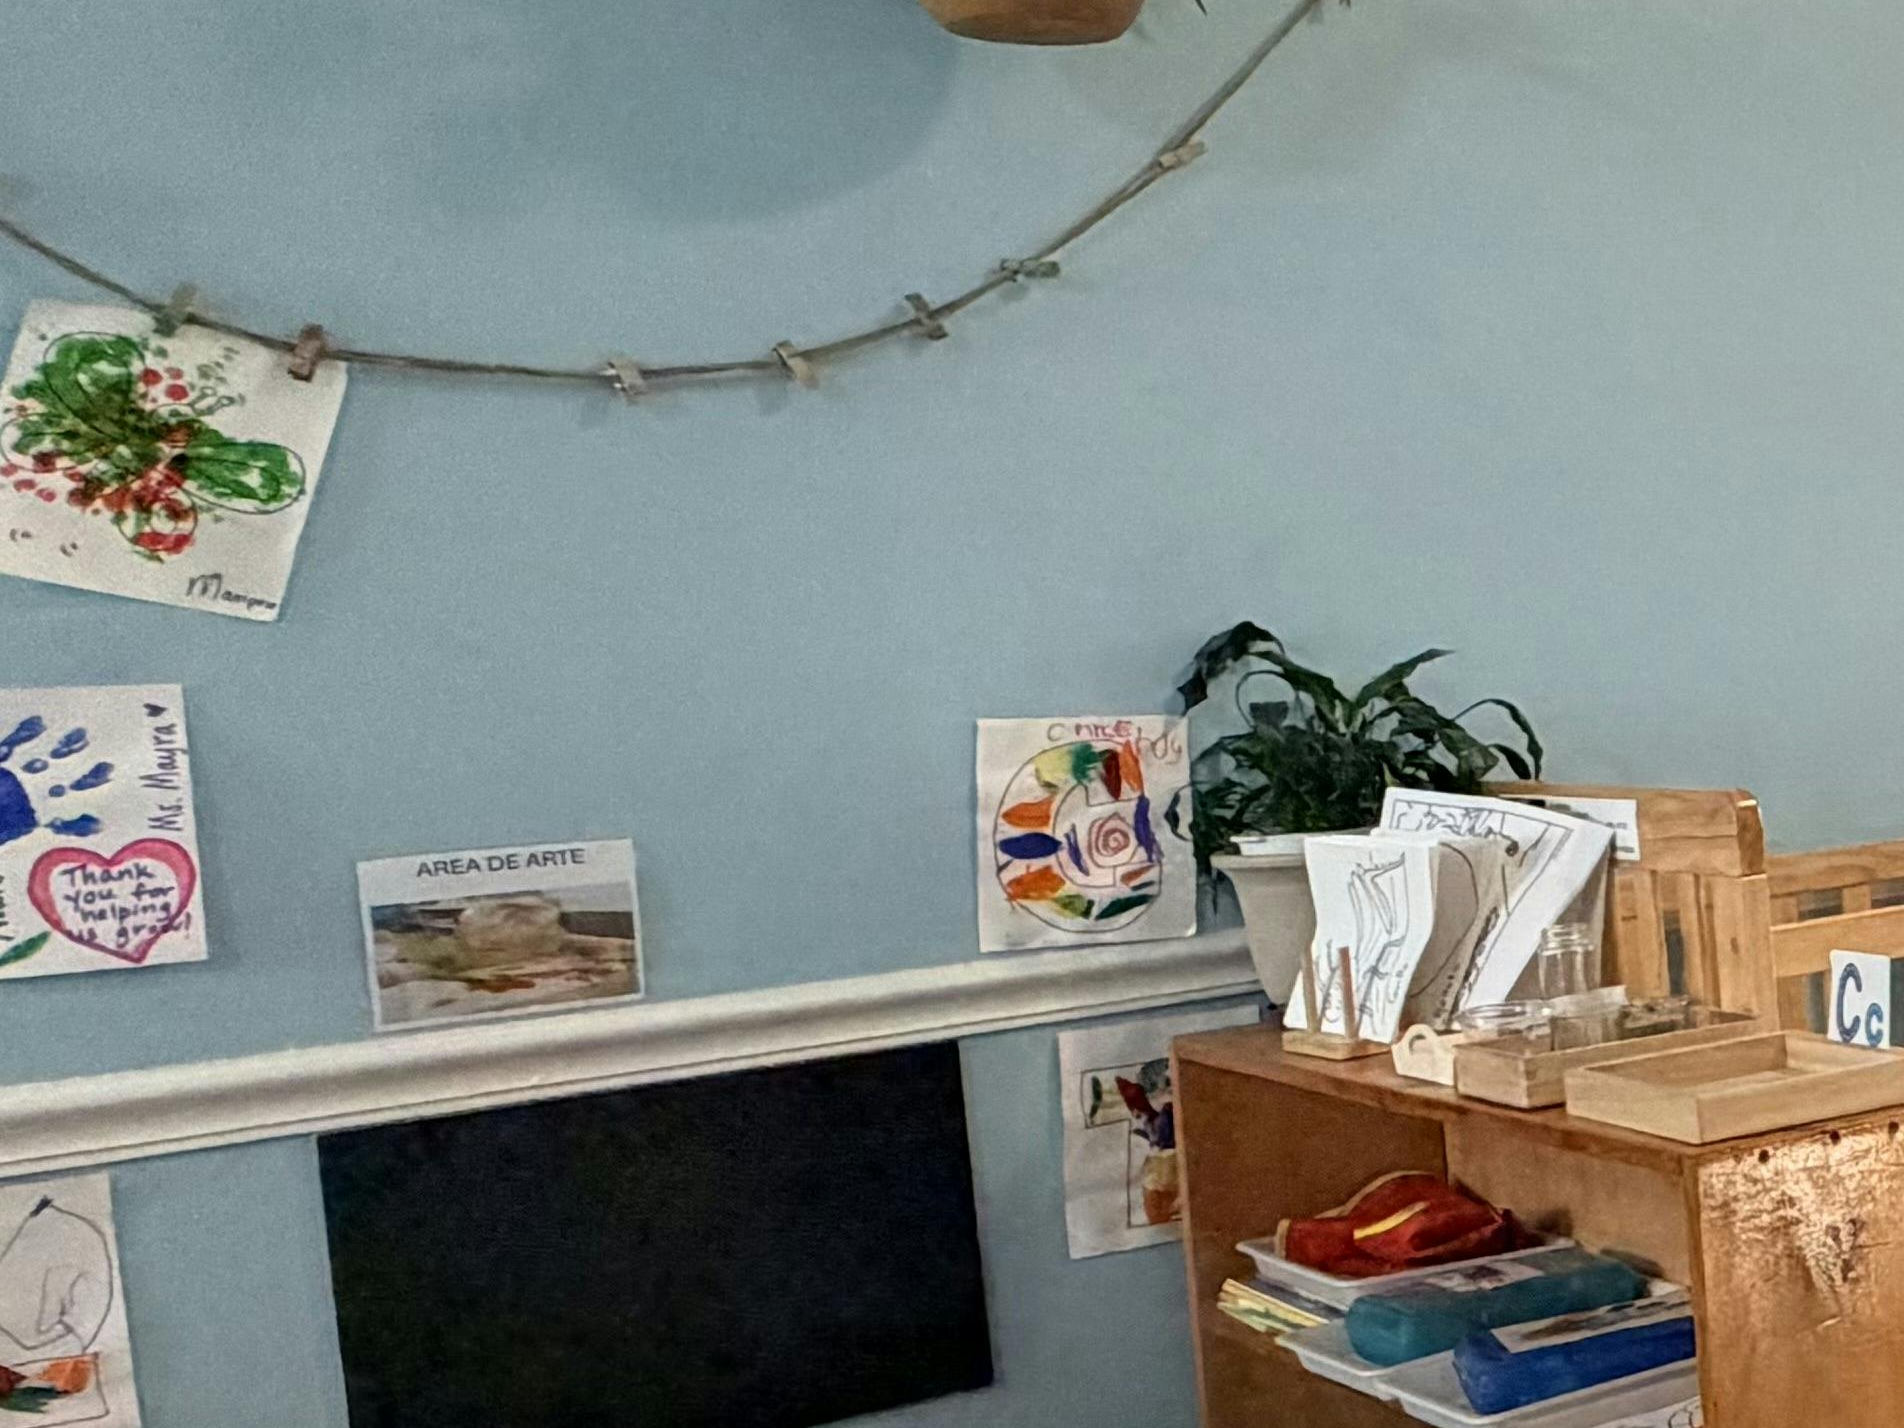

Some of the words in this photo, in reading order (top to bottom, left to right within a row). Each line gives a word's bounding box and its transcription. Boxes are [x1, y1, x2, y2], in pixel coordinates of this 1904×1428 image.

[139, 722, 188, 790] Mayra
[148, 796, 184, 832] Ms.
[59, 862, 155, 887] Thank
[416, 857, 481, 877] AREA
[487, 853, 520, 872] DE
[526, 848, 586, 868] ARTE
[130, 882, 176, 901] for
[79, 901, 173, 924] helping
